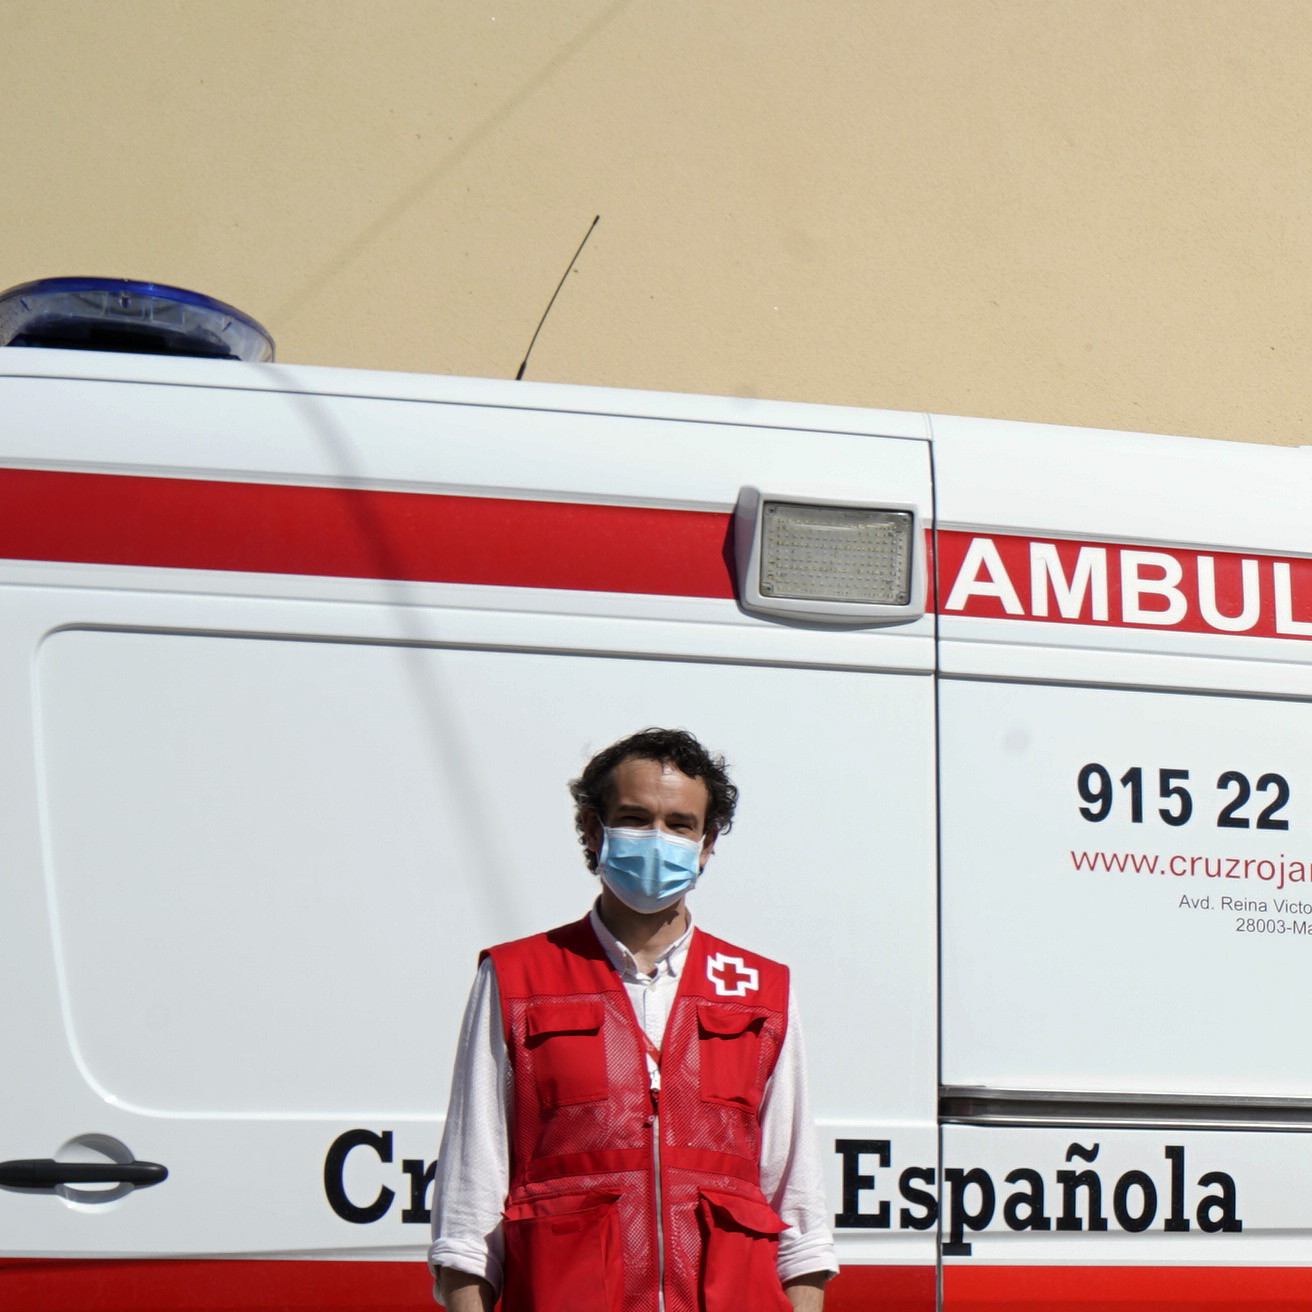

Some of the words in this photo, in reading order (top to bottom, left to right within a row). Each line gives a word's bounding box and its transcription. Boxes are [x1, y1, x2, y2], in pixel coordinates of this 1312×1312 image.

[1077, 762, 1193, 827] 915
[1216, 770, 1290, 831] 22
[1178, 894, 1215, 911] Avd.
[1221, 896, 1268, 913] Reina
[835, 1139, 1243, 1256] Española
